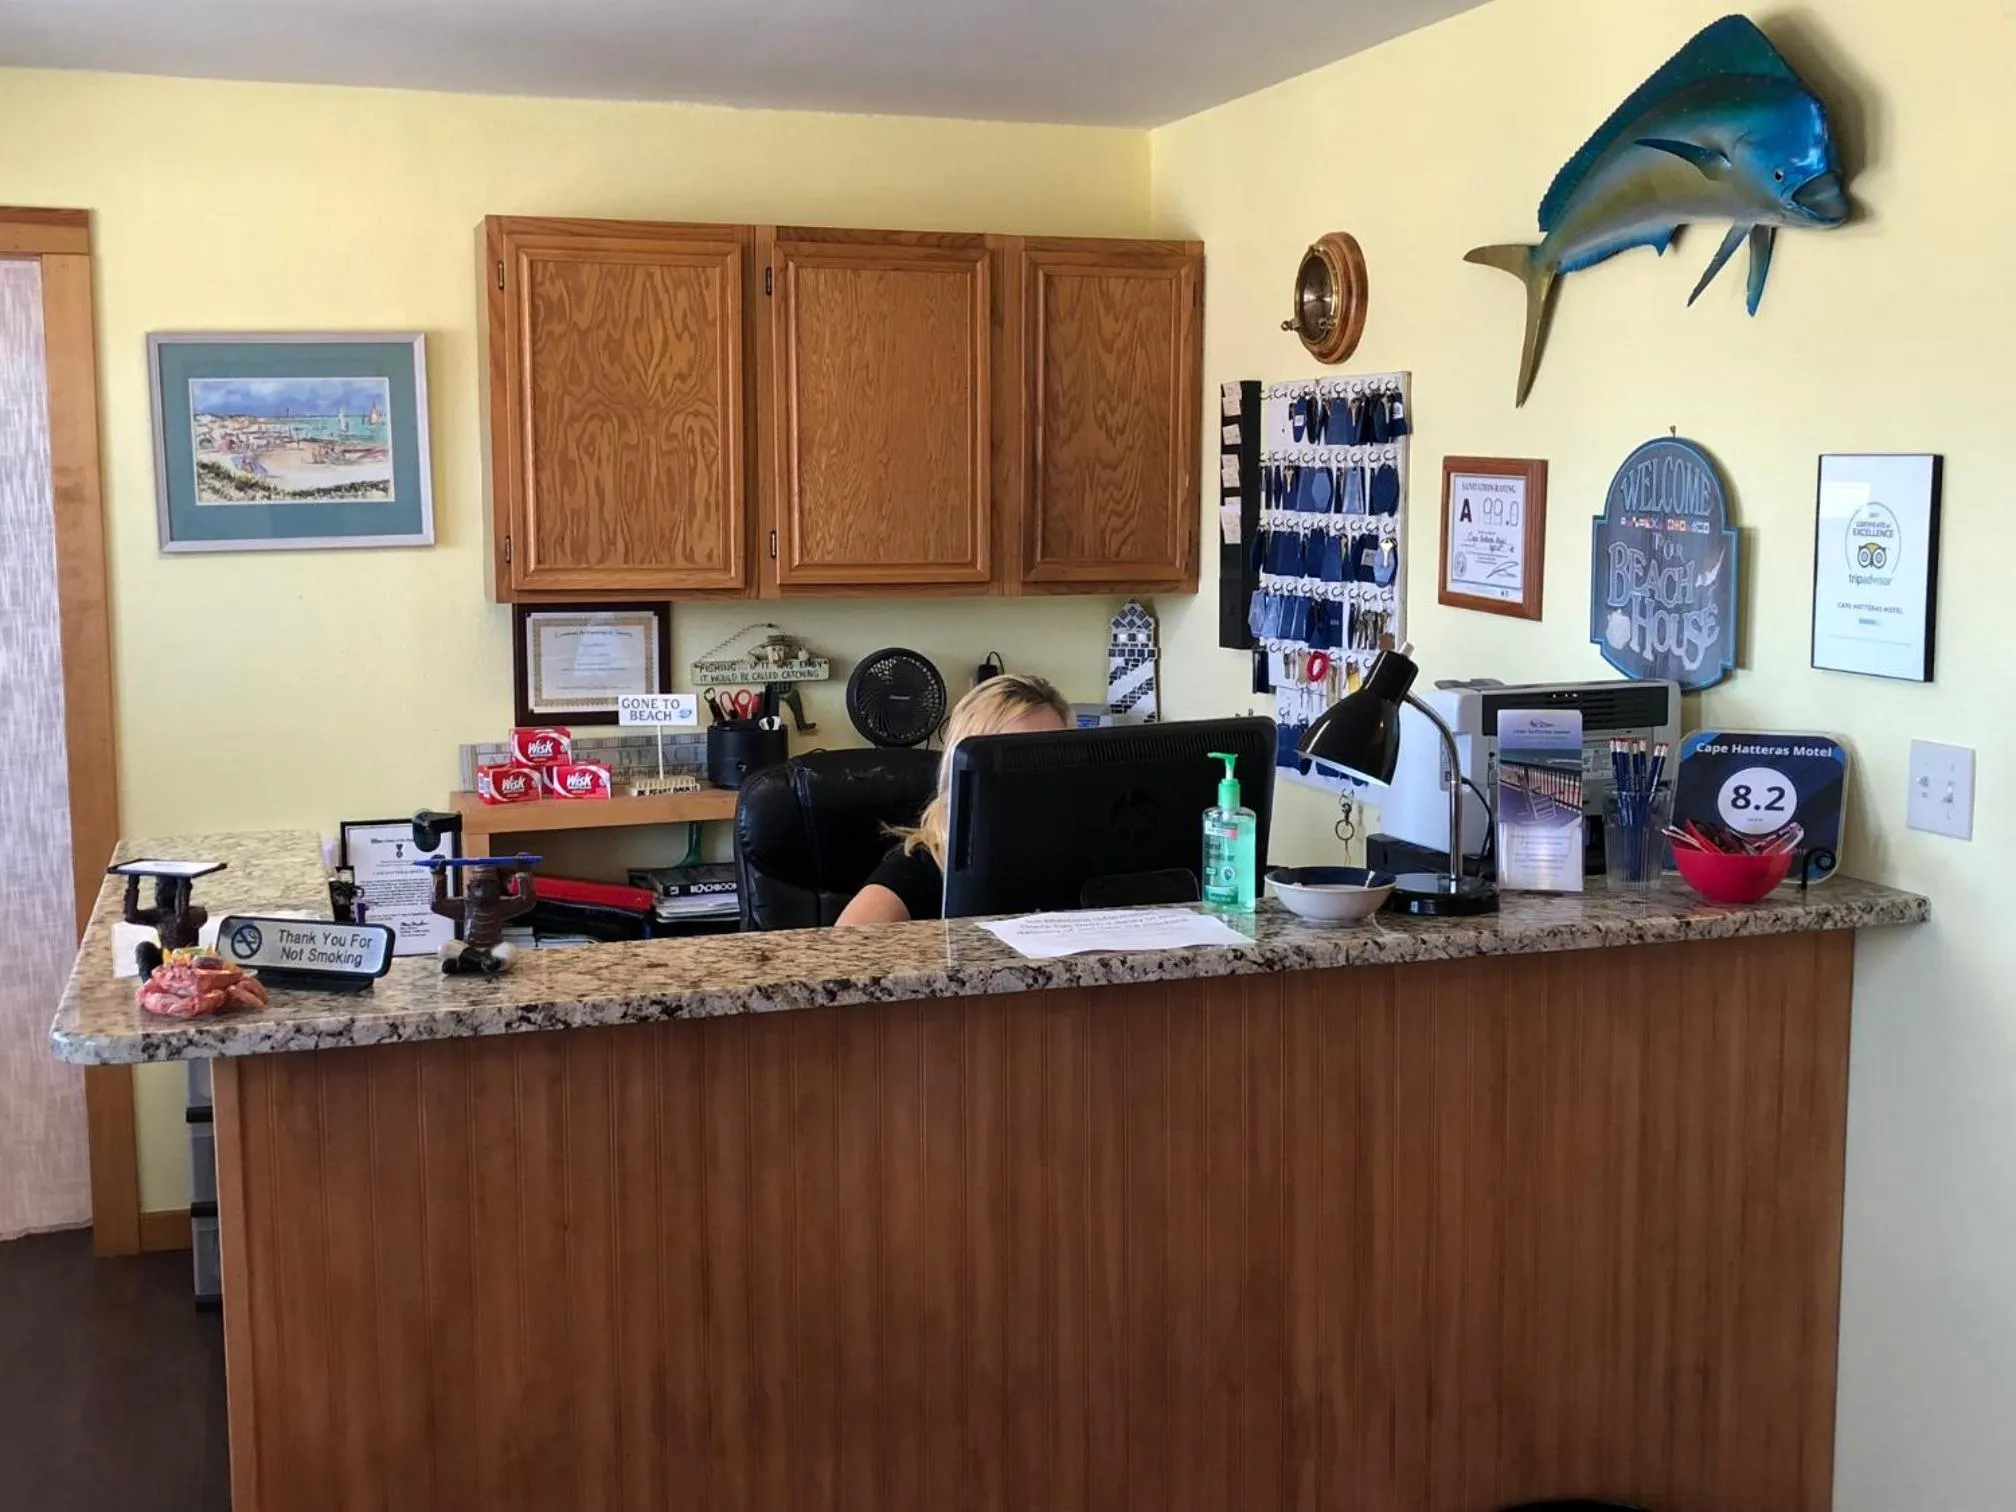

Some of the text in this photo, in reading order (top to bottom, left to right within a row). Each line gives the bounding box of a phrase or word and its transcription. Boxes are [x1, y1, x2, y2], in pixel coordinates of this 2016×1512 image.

[1621, 456, 1713, 516] WELCOME
[1459, 498, 1473, 523] A
[1607, 541, 1695, 608] BEACH
[1630, 591, 1720, 671] HOUSE
[621, 698, 680, 710] GONE TO
[630, 710, 672, 721] BEACH
[1695, 743, 1832, 757] Cape Hatteras Motel
[1730, 784, 1786, 812] 8.2
[279, 929, 374, 949] Thank You For
[280, 946, 364, 968] Not Smoking
